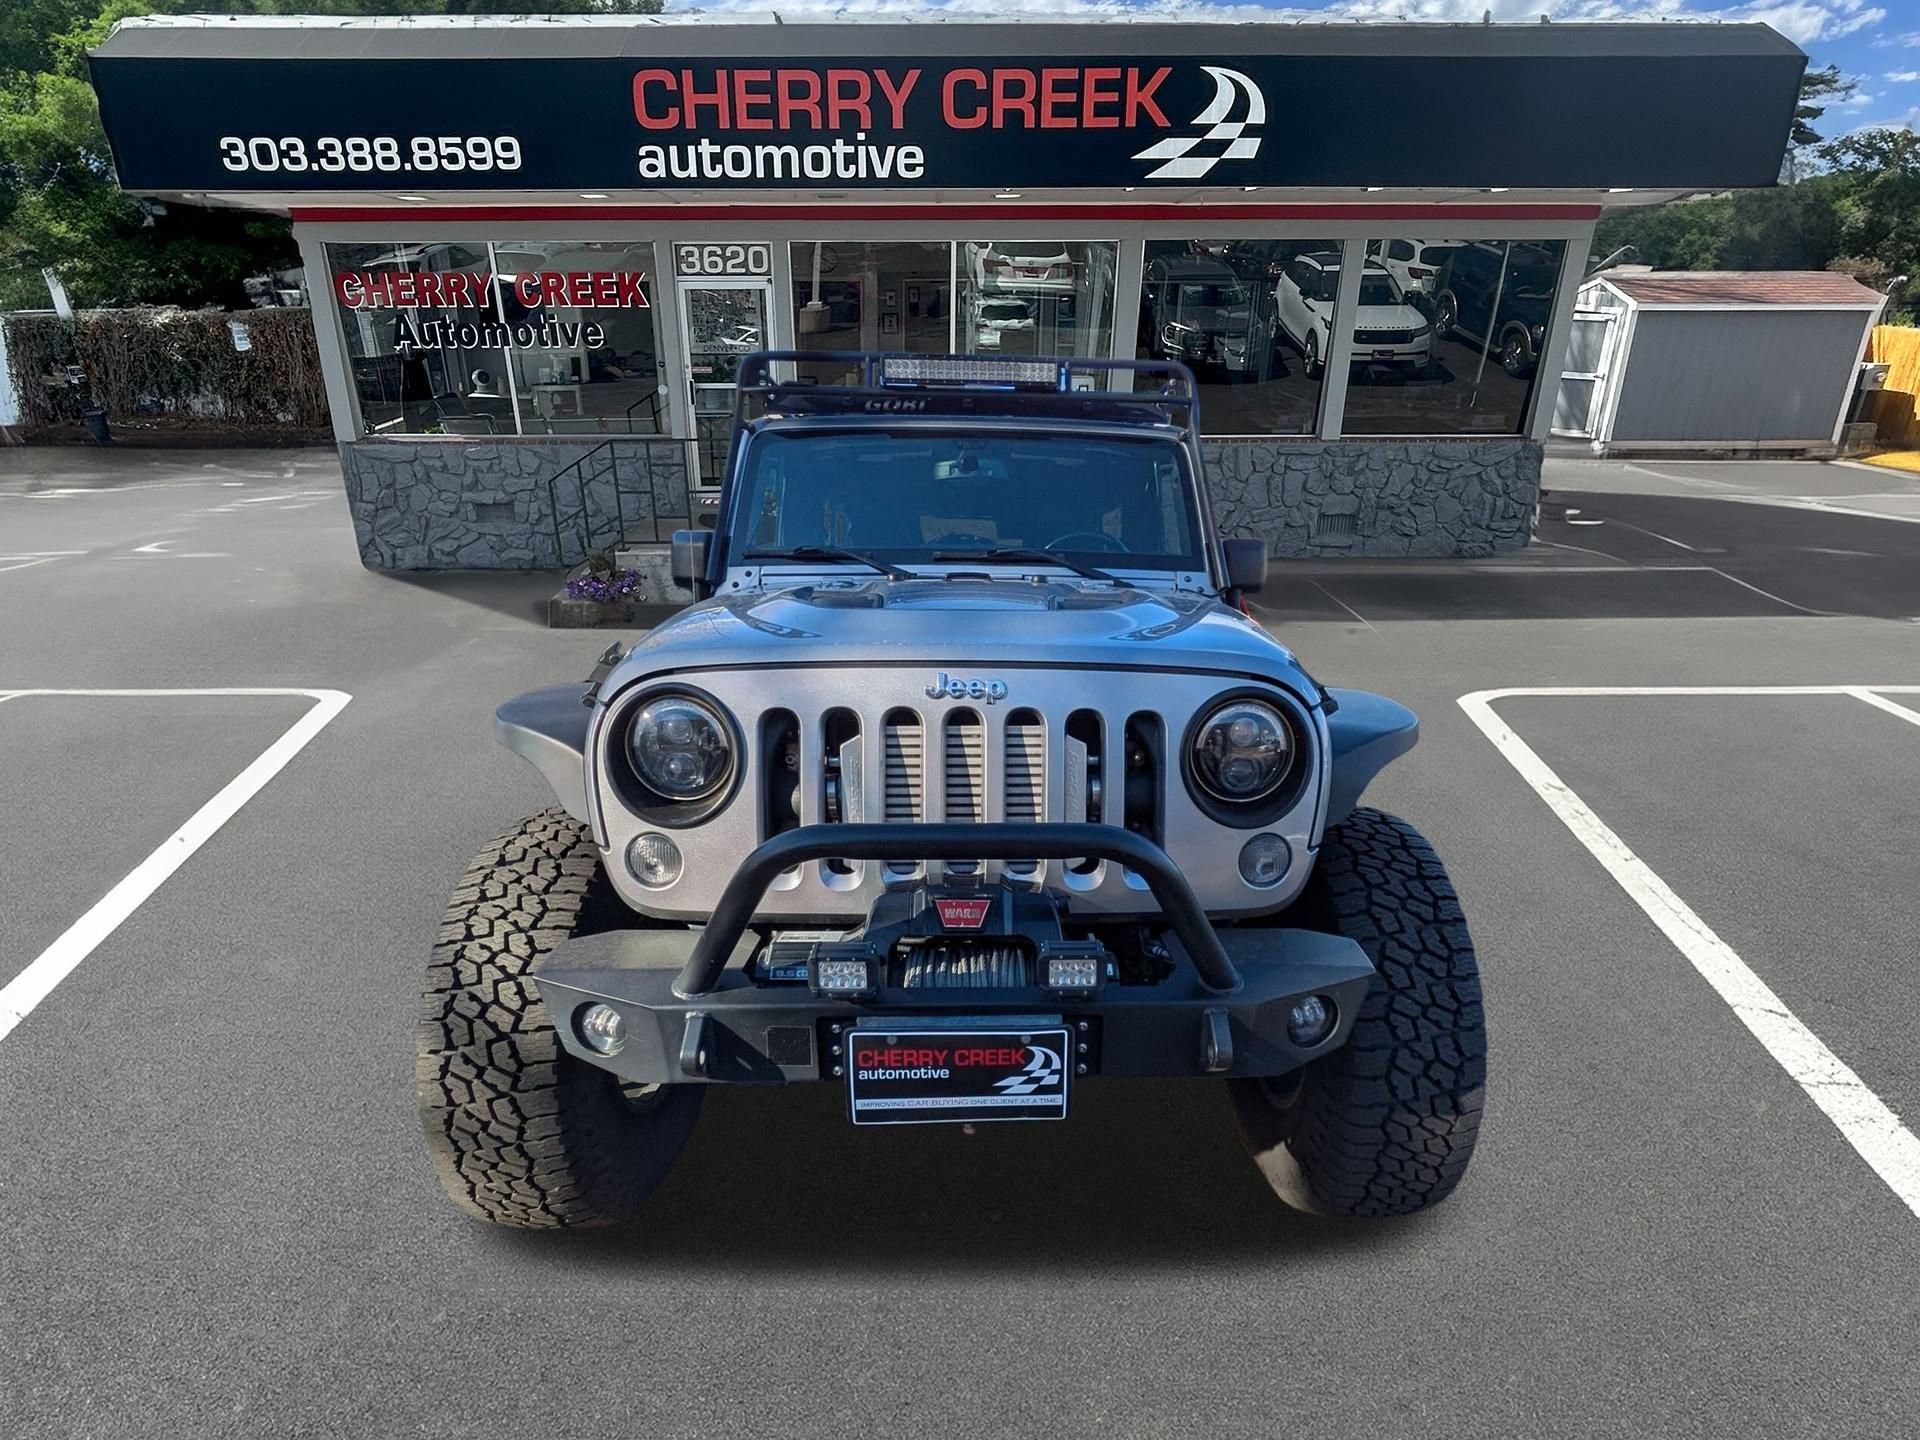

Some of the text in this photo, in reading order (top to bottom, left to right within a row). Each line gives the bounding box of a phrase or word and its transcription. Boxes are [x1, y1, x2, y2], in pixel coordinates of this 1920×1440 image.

[631, 66, 1174, 131] CHERRY CREEK
[219, 136, 523, 171] 303.388.8599
[638, 132, 925, 180] automotive
[679, 246, 769, 274] 3620
[335, 271, 650, 308] CHERRY CREEK
[393, 313, 607, 351] Automotive
[924, 672, 1009, 705] Jeep
[857, 1048, 1026, 1067] CHERRY CREEK
[858, 1066, 950, 1080] automotive
[931, 1098, 969, 1106] BUYING
